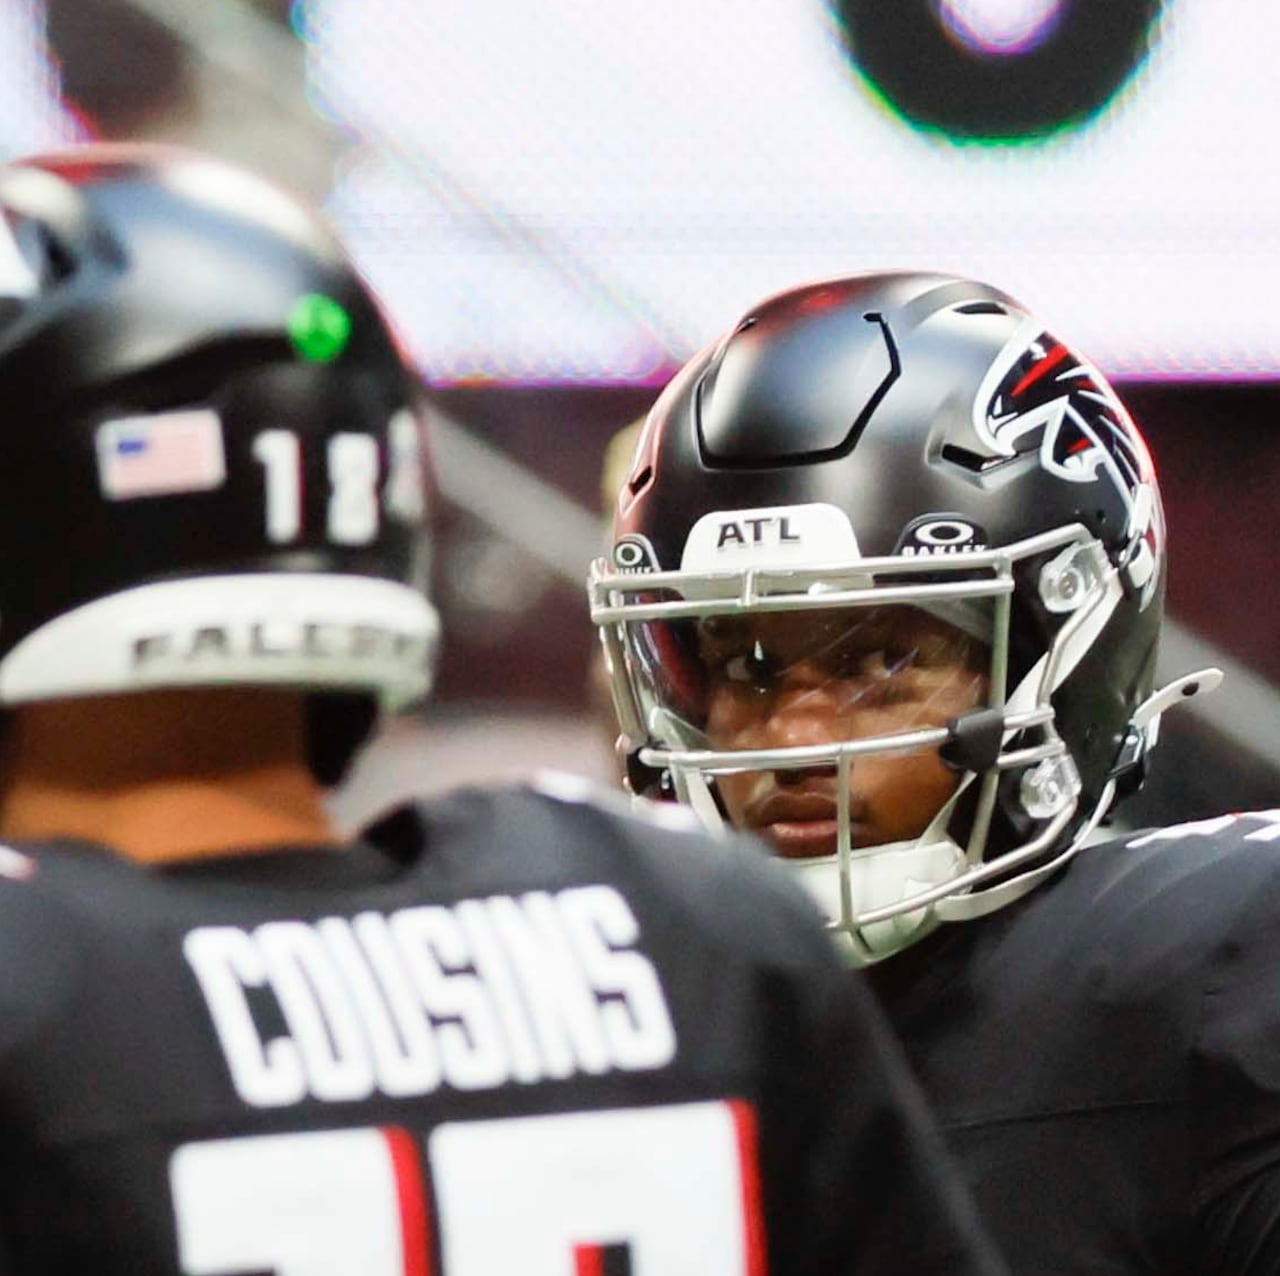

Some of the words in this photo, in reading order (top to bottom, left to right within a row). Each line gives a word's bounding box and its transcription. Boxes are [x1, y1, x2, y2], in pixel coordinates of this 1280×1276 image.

[251, 429, 380, 546] 18
[717, 517, 800, 548] ATL
[184, 884, 676, 1107] COUSINS
